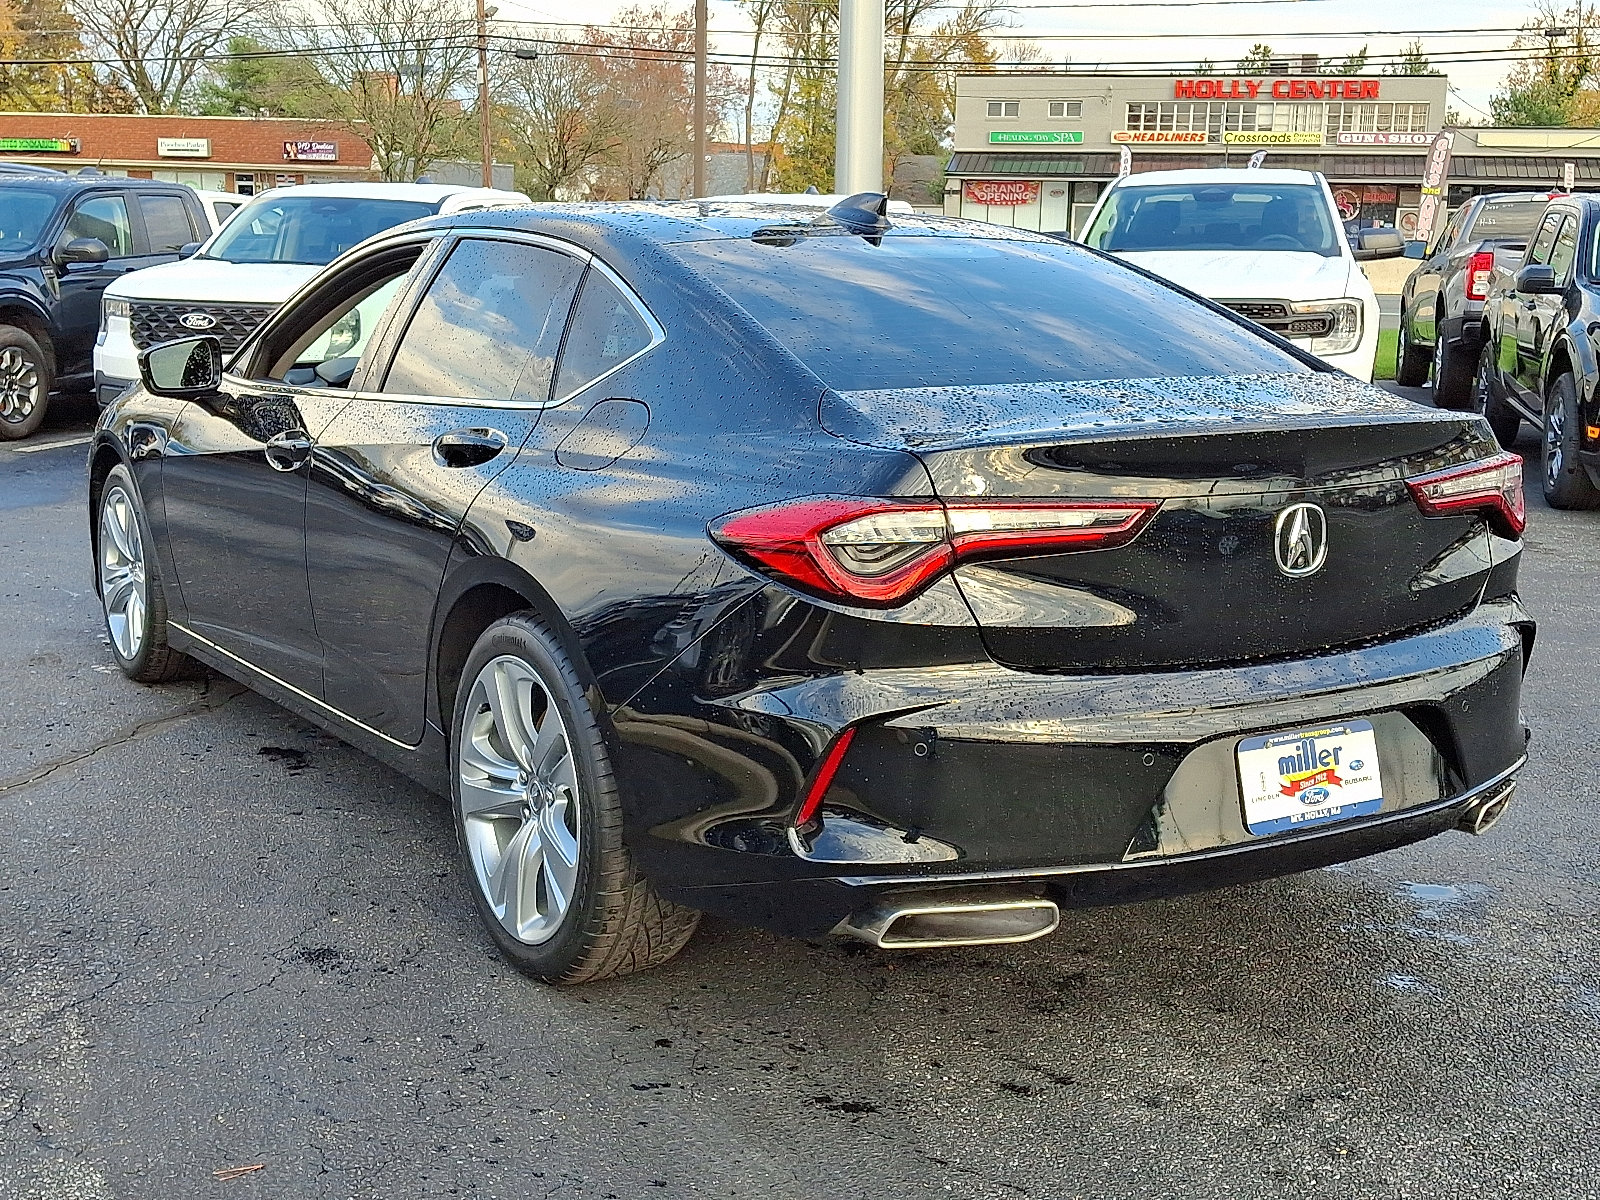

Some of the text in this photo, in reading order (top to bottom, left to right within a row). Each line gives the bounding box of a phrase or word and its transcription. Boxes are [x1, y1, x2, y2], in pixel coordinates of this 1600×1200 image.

[1174, 80, 1380, 98] HOLLY CENTER
[1052, 132, 1075, 142] SPA
[1132, 132, 1206, 142] HEADLINERS
[1224, 132, 1292, 142] Crossroads
[1339, 134, 1437, 144] GUN SHOP
[1428, 138, 1448, 186] GUNS
[982, 184, 1025, 193] GRAND
[978, 192, 1030, 202] OPENING
[186, 316, 209, 326] Ford
[1268, 726, 1344, 743] www.millertransgroup.com
[1278, 738, 1342, 775] miller
[1299, 778, 1314, 789] Since
[1344, 777, 1372, 786] SUBARU
[1252, 794, 1280, 804] LINCOLN
[1304, 790, 1326, 804] Ford
[1330, 806, 1342, 815] NJ
